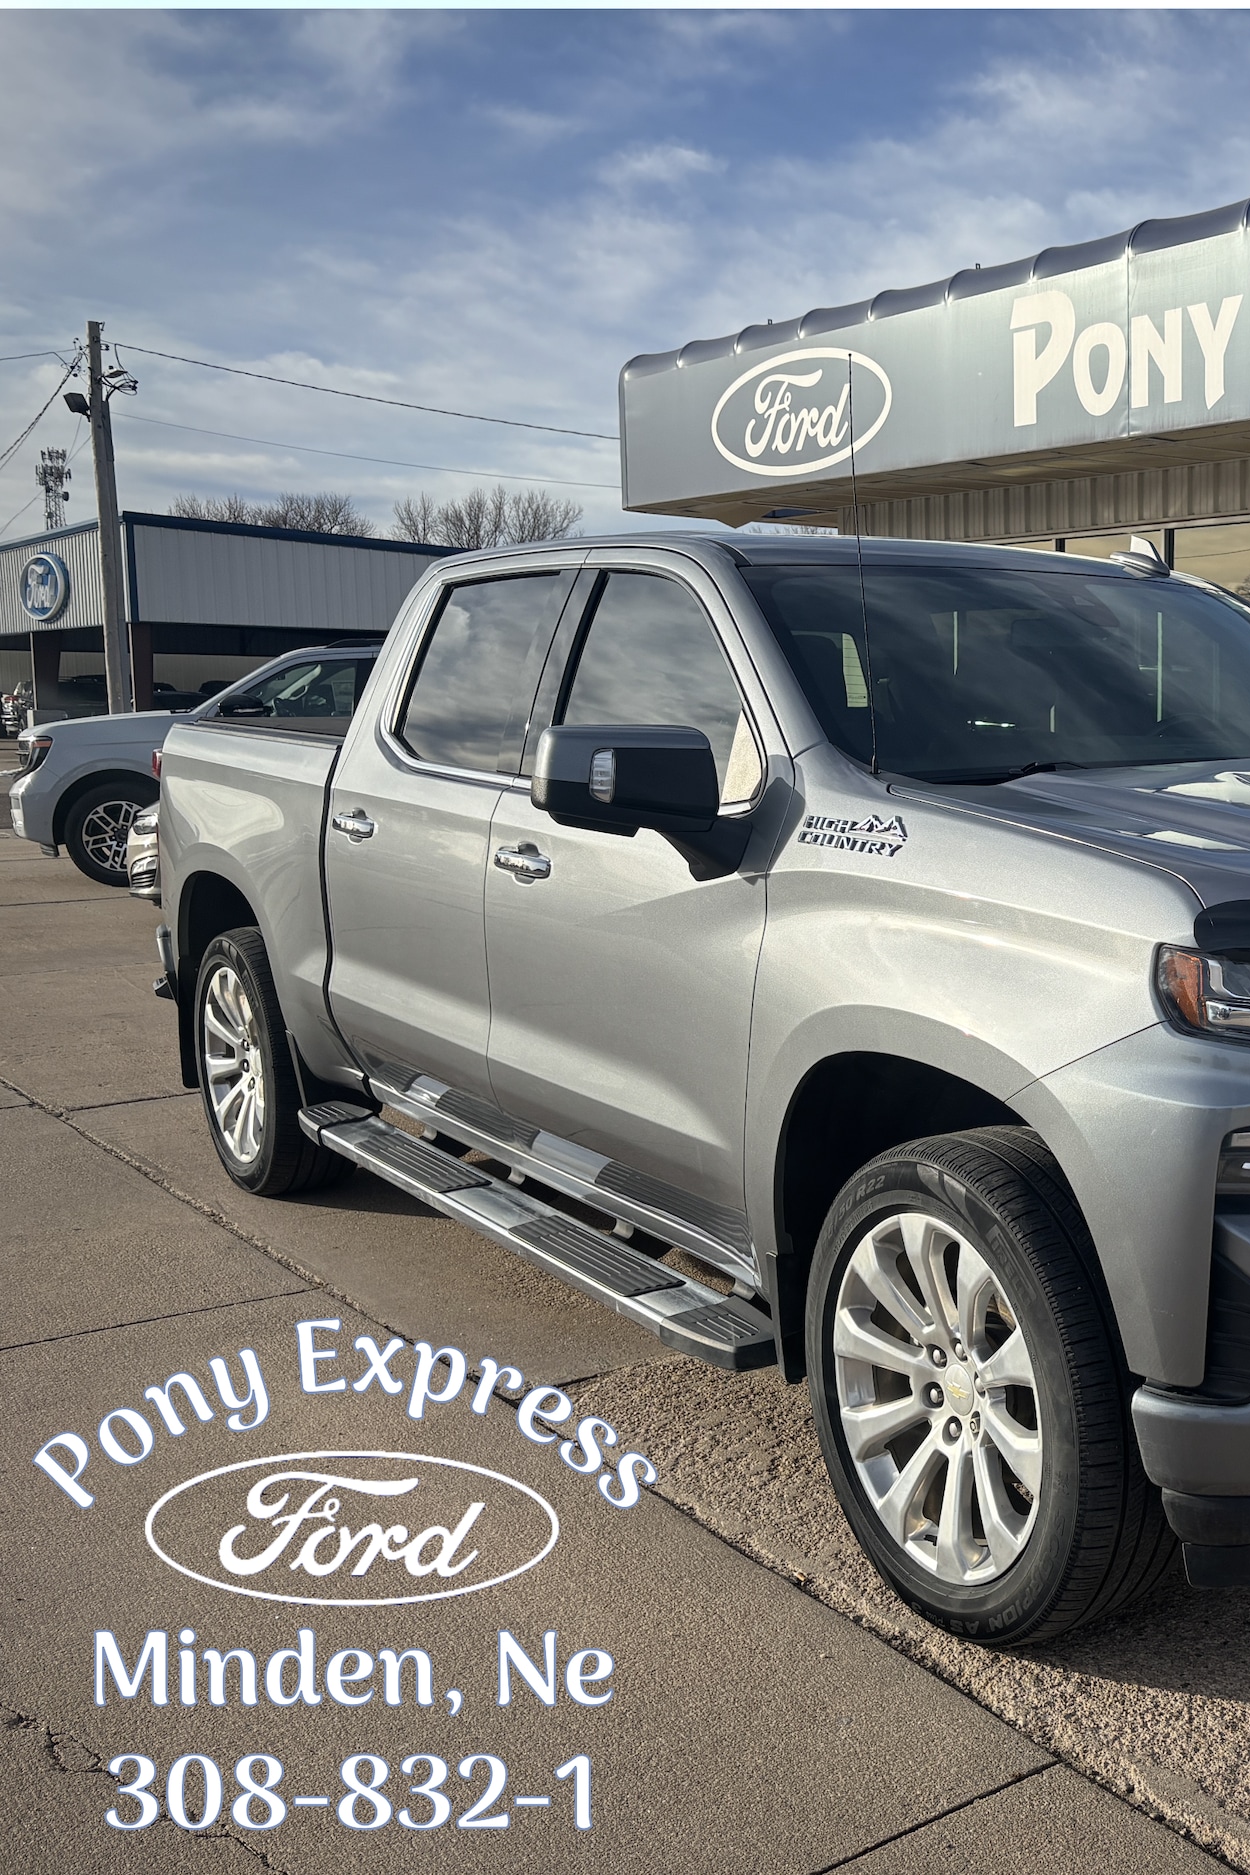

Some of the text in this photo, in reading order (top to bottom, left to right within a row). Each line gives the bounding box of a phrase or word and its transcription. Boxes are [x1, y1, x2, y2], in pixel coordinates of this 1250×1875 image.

[1009, 290, 1243, 428] PONY
[744, 368, 851, 458] Ford
[26, 563, 57, 609] Ford
[804, 815, 852, 833] HIGH
[798, 831, 903, 857] COUNTRY
[950, 1619, 980, 1635] AS
